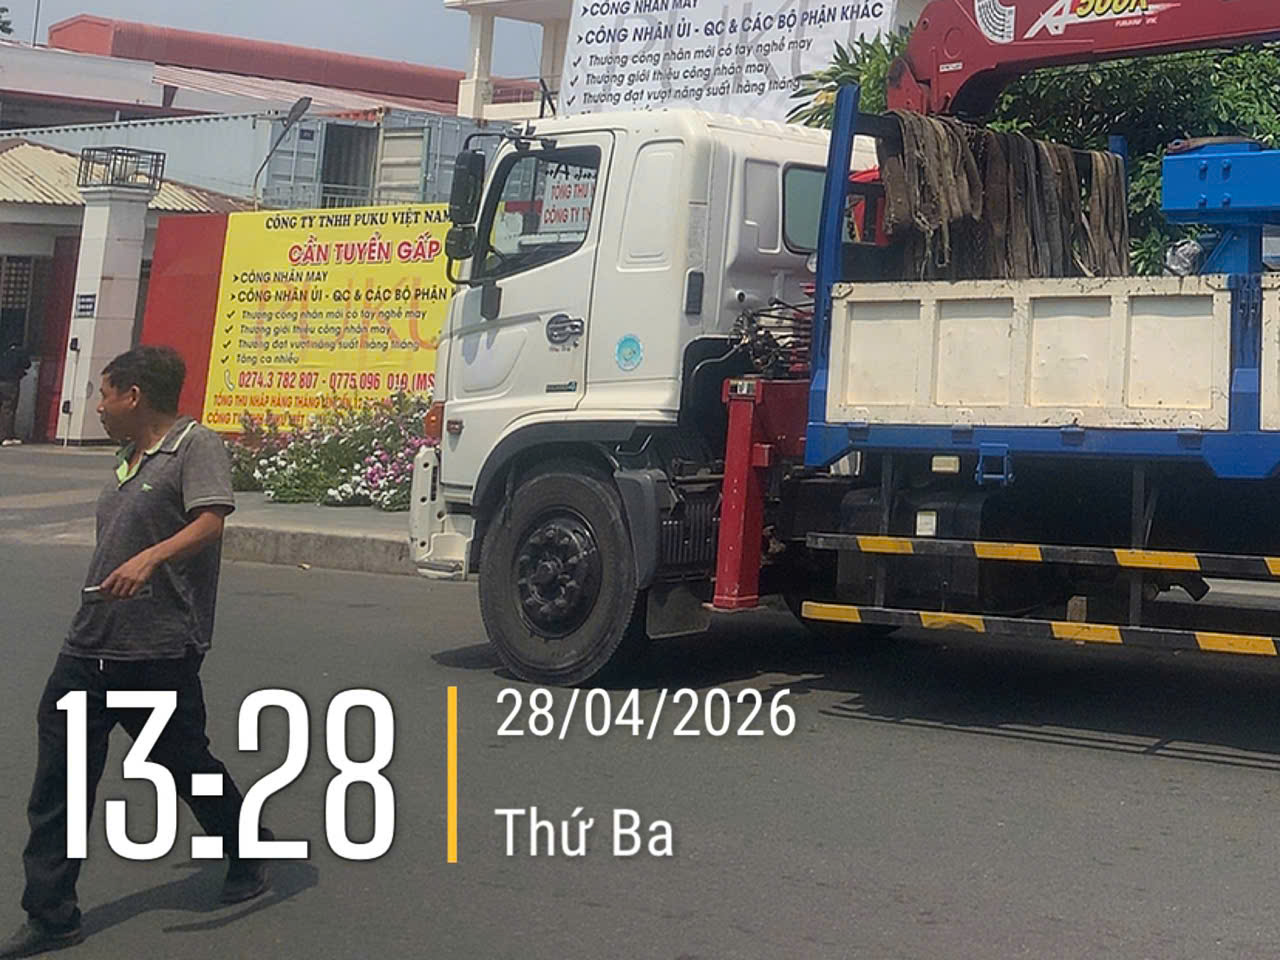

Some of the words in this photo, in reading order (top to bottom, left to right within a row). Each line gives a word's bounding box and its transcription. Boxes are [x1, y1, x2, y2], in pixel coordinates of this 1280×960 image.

[585, 25, 628, 45] CÔNG
[632, 21, 673, 42] NHÂN
[704, 20, 726, 37] QC
[728, 18, 738, 34] &
[741, 11, 774, 32] CÁC
[777, 8, 797, 33] BỘ
[800, 4, 837, 29] PHẬN
[631, 50, 661, 66] công
[663, 47, 691, 61] nhân
[718, 43, 732, 57] có
[735, 43, 753, 56] tay
[756, 36, 785, 56] nghề
[787, 38, 813, 50] may
[682, 65, 711, 81] công
[713, 62, 743, 76] nhân
[745, 63, 771, 74] may
[624, 89, 644, 104] đạt
[705, 80, 731, 97] suất
[768, 76, 800, 91] tháng
[265, 213, 298, 229] CÔNG
[301, 215, 316, 229] TY
[318, 214, 352, 228] TNHH
[354, 212, 389, 226] PUKU
[391, 207, 422, 228] VIỆT
[288, 234, 330, 266] CẦN
[334, 231, 392, 265] TUYỂN
[396, 231, 443, 263] GẤP
[240, 269, 272, 283] CÔNG
[273, 268, 304, 282] NHÂN
[305, 271, 328, 282] MAY
[237, 287, 272, 302] CÔNG
[274, 286, 309, 302] NHÂN
[332, 288, 351, 301] QC
[354, 289, 362, 301] &
[365, 284, 392, 302] CÁC
[394, 284, 411, 304] BỘ
[414, 284, 448, 304] PHẬN
[239, 371, 274, 388] 0274.3
[277, 371, 297, 389] 782
[299, 371, 319, 389] 807
